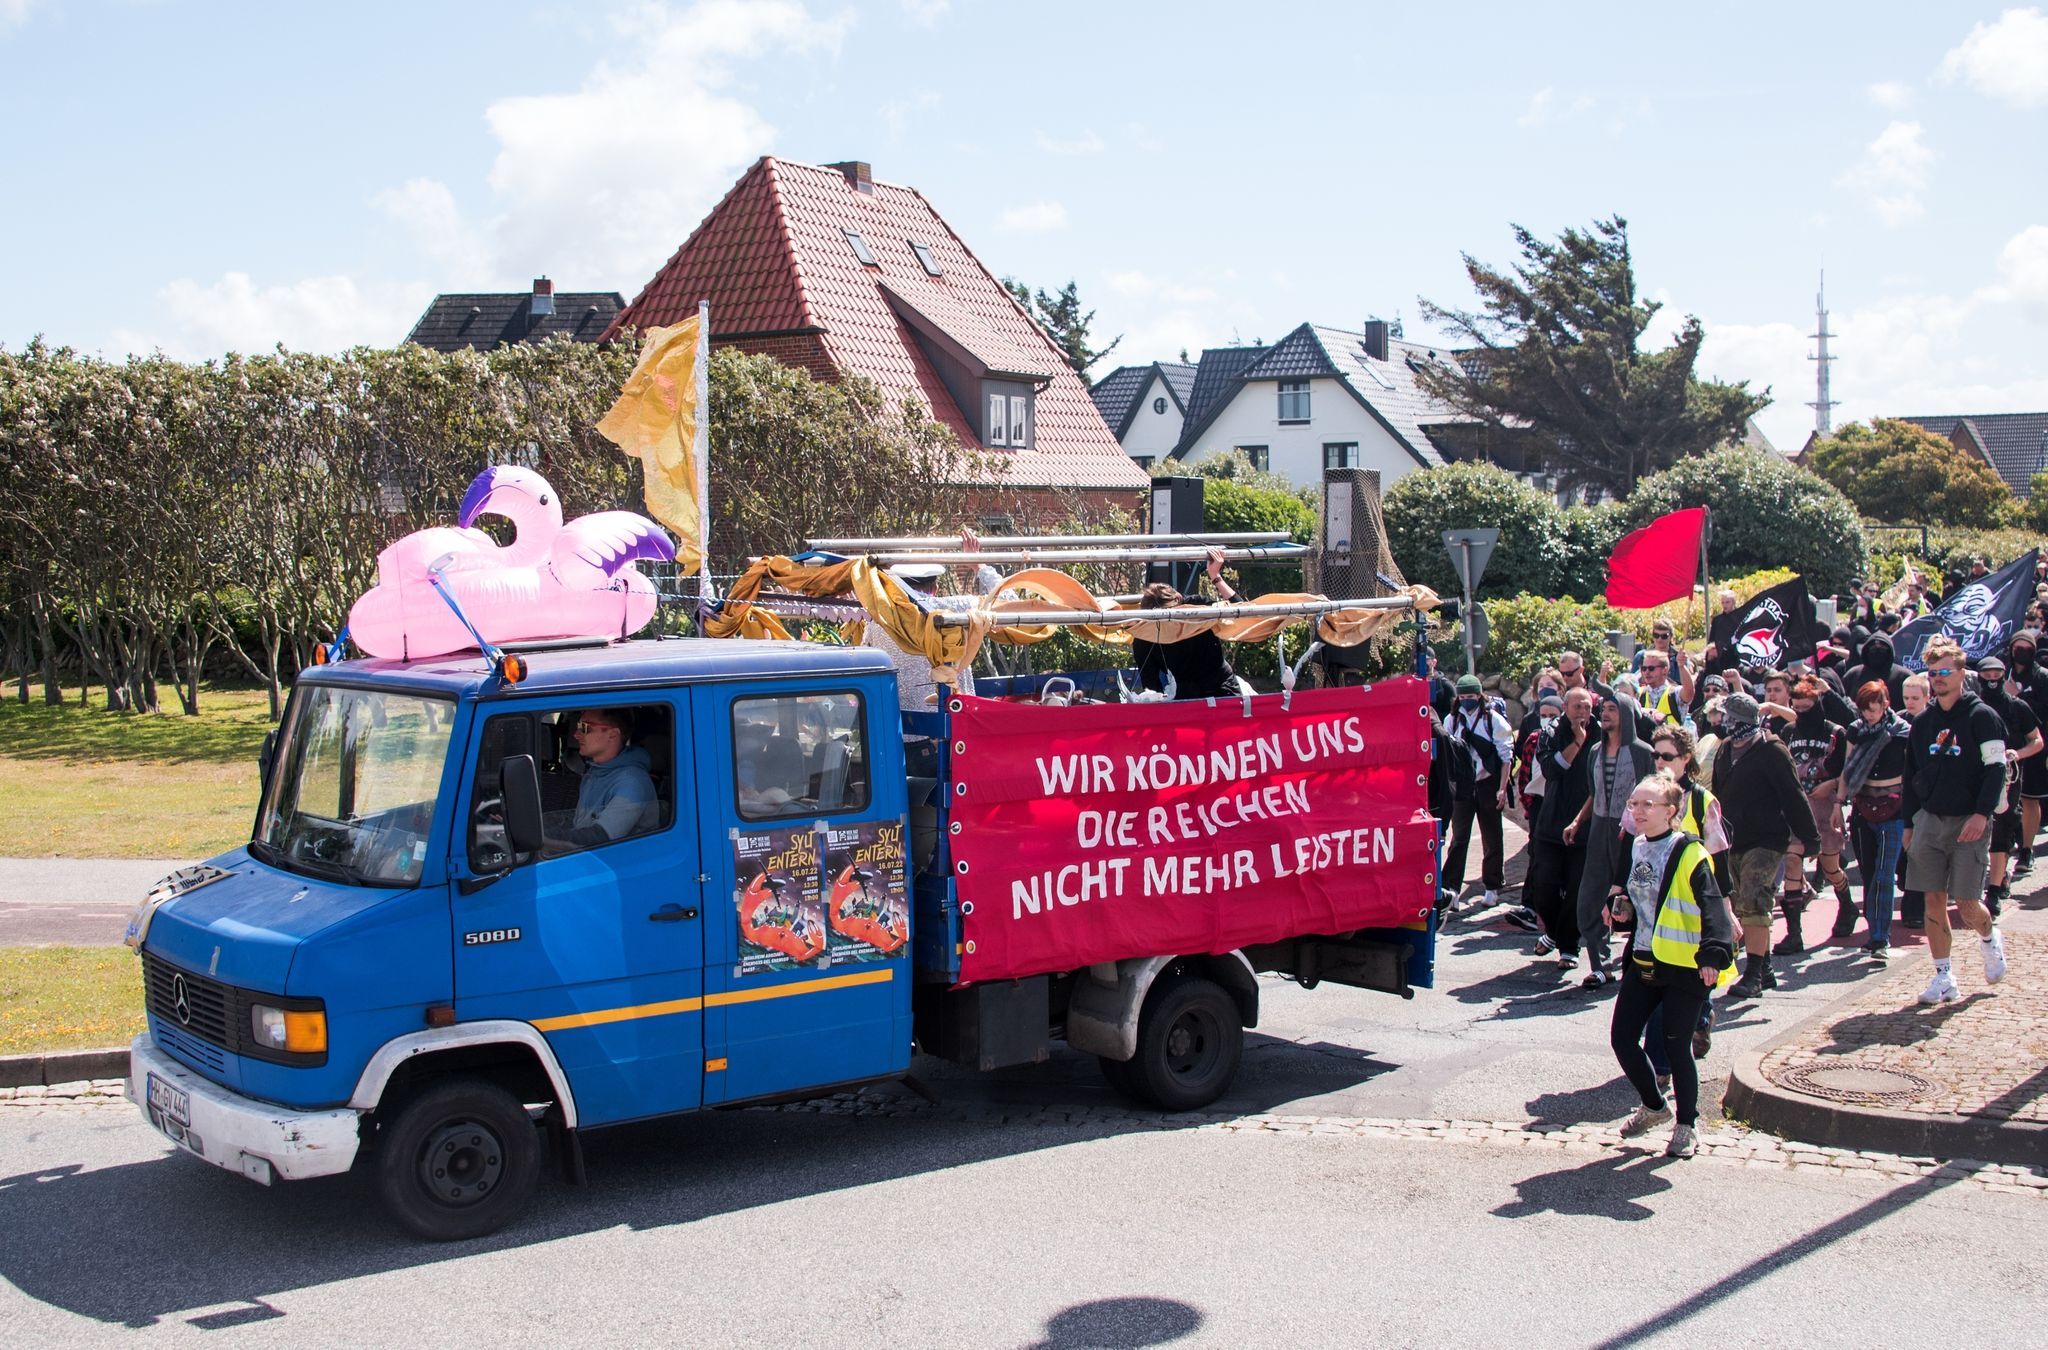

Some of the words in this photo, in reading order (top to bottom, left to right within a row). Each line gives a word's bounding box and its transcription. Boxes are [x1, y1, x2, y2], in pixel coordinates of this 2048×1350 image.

[1036, 754, 1116, 796] WIR
[1125, 734, 1283, 792] KÖNNEN
[1291, 717, 1365, 762] UNS
[1077, 811, 1139, 848] DIE
[1147, 780, 1311, 844] REICHEN
[791, 830, 816, 853] SYLT
[878, 824, 903, 846] SYLT
[767, 849, 816, 870] ENTERN
[855, 842, 902, 863] ENTERN
[792, 867, 818, 877] 16.07.22
[878, 861, 903, 870] 16.07.22
[1011, 858, 1131, 920] NICHT
[1143, 849, 1260, 897] MEHR
[1270, 828, 1395, 878] LEISTEN
